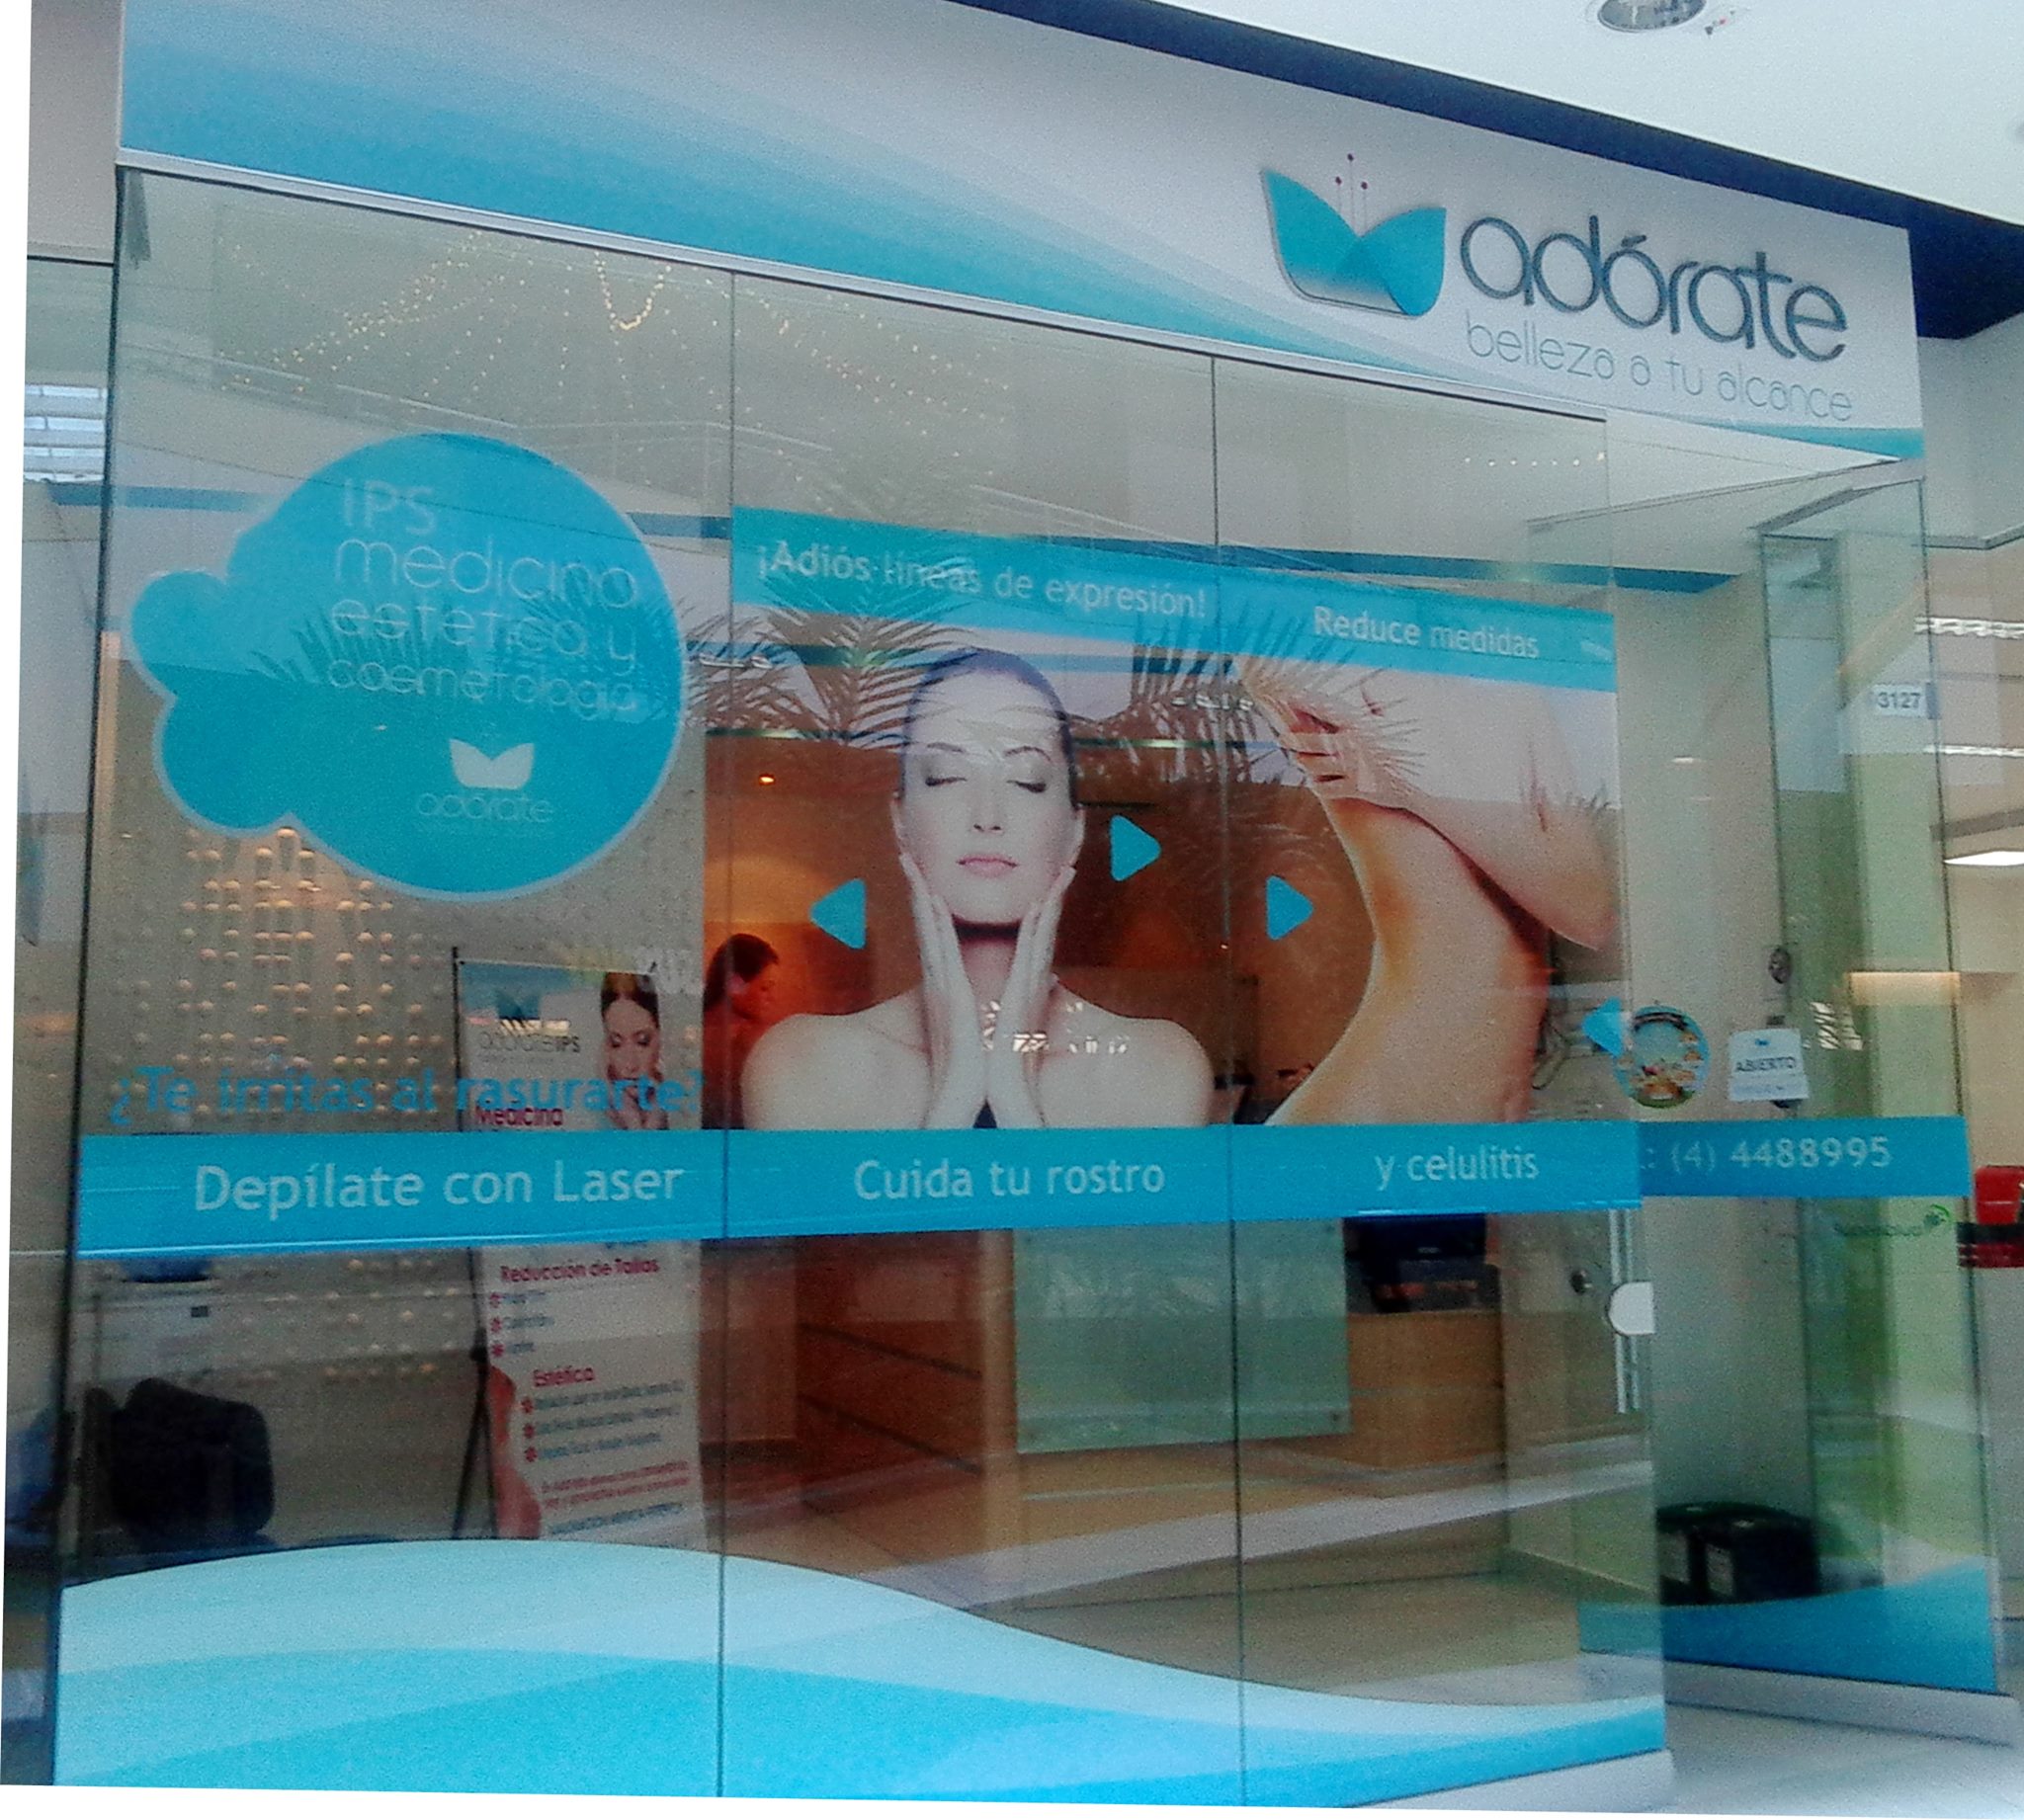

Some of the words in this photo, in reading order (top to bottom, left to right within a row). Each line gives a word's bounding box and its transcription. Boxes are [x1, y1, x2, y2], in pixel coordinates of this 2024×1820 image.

[1460, 214, 1847, 362] adórate
[1466, 316, 1615, 380] belleza
[1631, 356, 1652, 386] a
[1670, 360, 1704, 396] tu
[1717, 365, 1853, 422] alcance
[342, 479, 436, 535] IPS
[335, 538, 637, 608] medicina
[993, 566, 1035, 600] de
[1045, 577, 1207, 619] expresión!
[608, 624, 637, 676] y
[1313, 606, 1421, 646] Reduce
[1429, 625, 1540, 660] medidas
[1878, 692, 1921, 709] 3127
[109, 1066, 197, 1126] ¿Te
[391, 1067, 438, 1112] al
[854, 1158, 973, 1200] Cuida
[988, 1162, 1031, 1198] tu
[1047, 1161, 1166, 1195] rostro
[1375, 1154, 1395, 1191] y
[1405, 1144, 1541, 1183] celulitis
[1670, 1137, 1716, 1174] (4)
[1729, 1135, 1892, 1170] 4488995
[196, 1163, 424, 1221] Depílate
[443, 1170, 534, 1205] con
[553, 1160, 685, 1203] Laser
